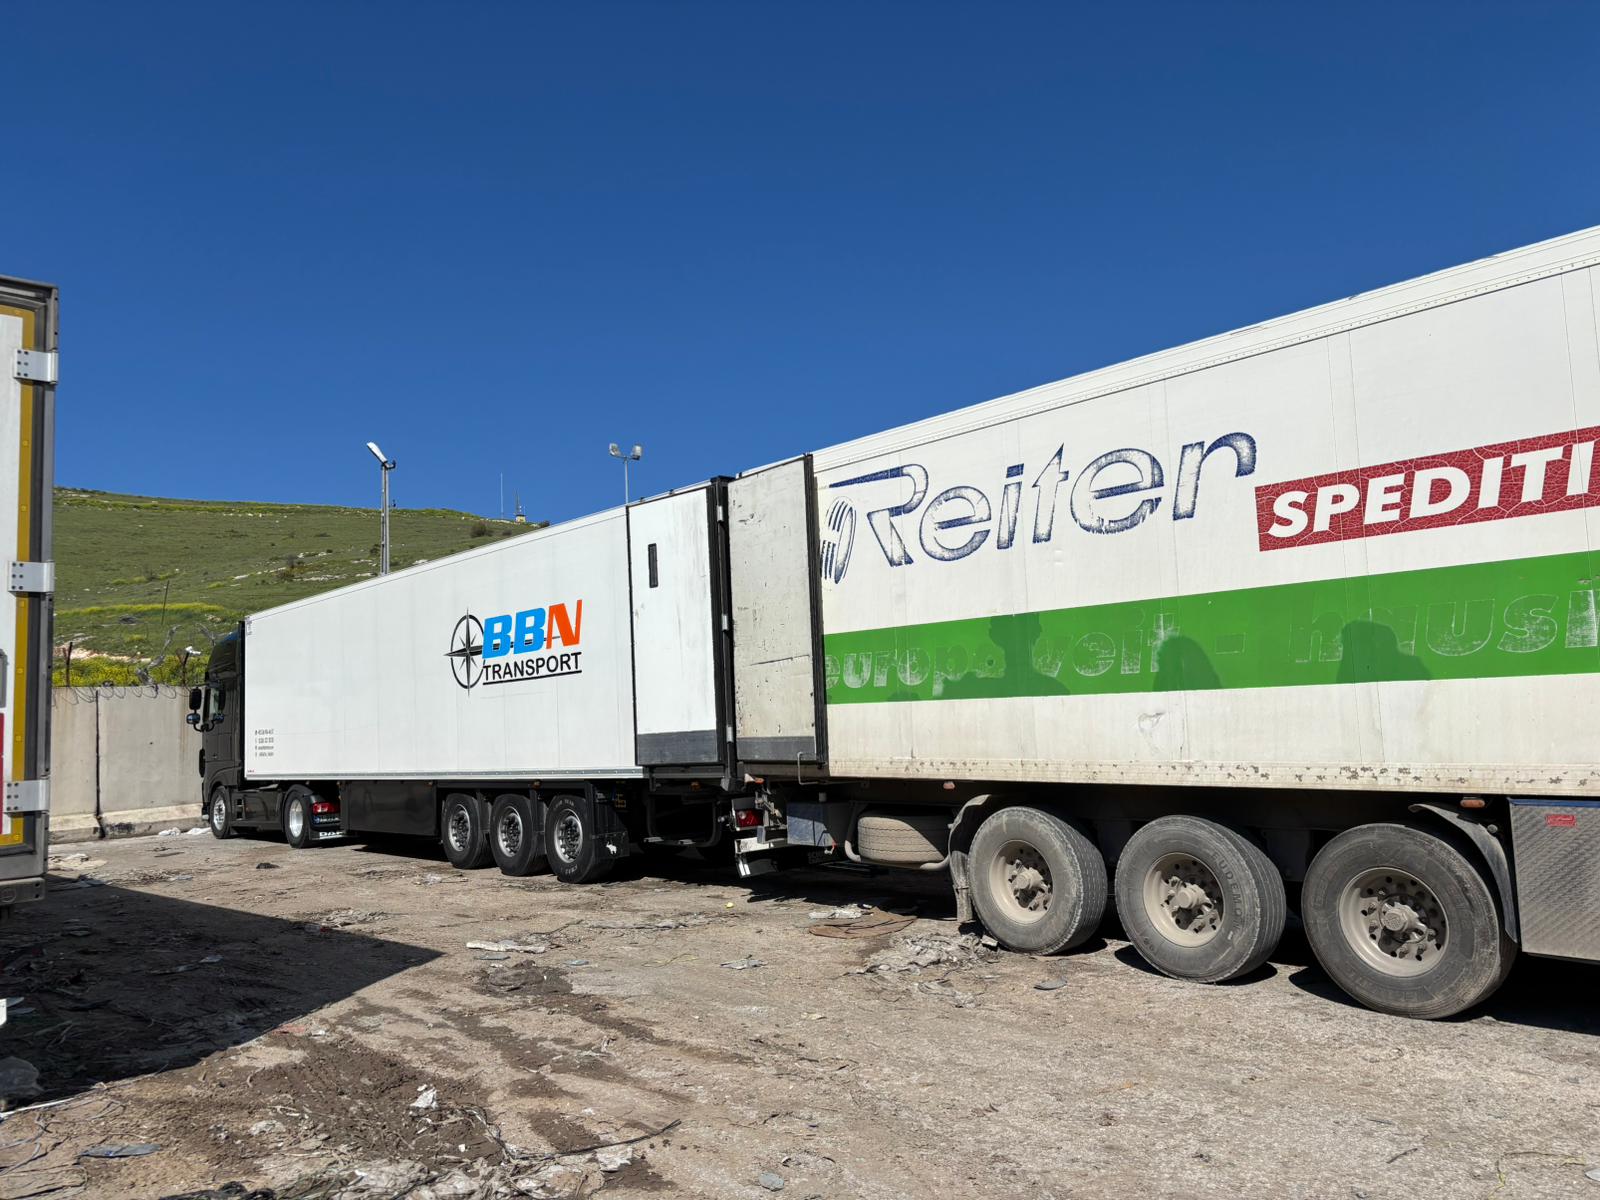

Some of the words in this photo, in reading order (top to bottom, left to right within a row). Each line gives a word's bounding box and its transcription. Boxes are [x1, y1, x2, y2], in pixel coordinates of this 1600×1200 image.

[828, 431, 1257, 568] Reiter
[1267, 440, 1595, 538] SPEDITI
[482, 599, 583, 659] BBN
[483, 651, 582, 681] TRANSPORT
